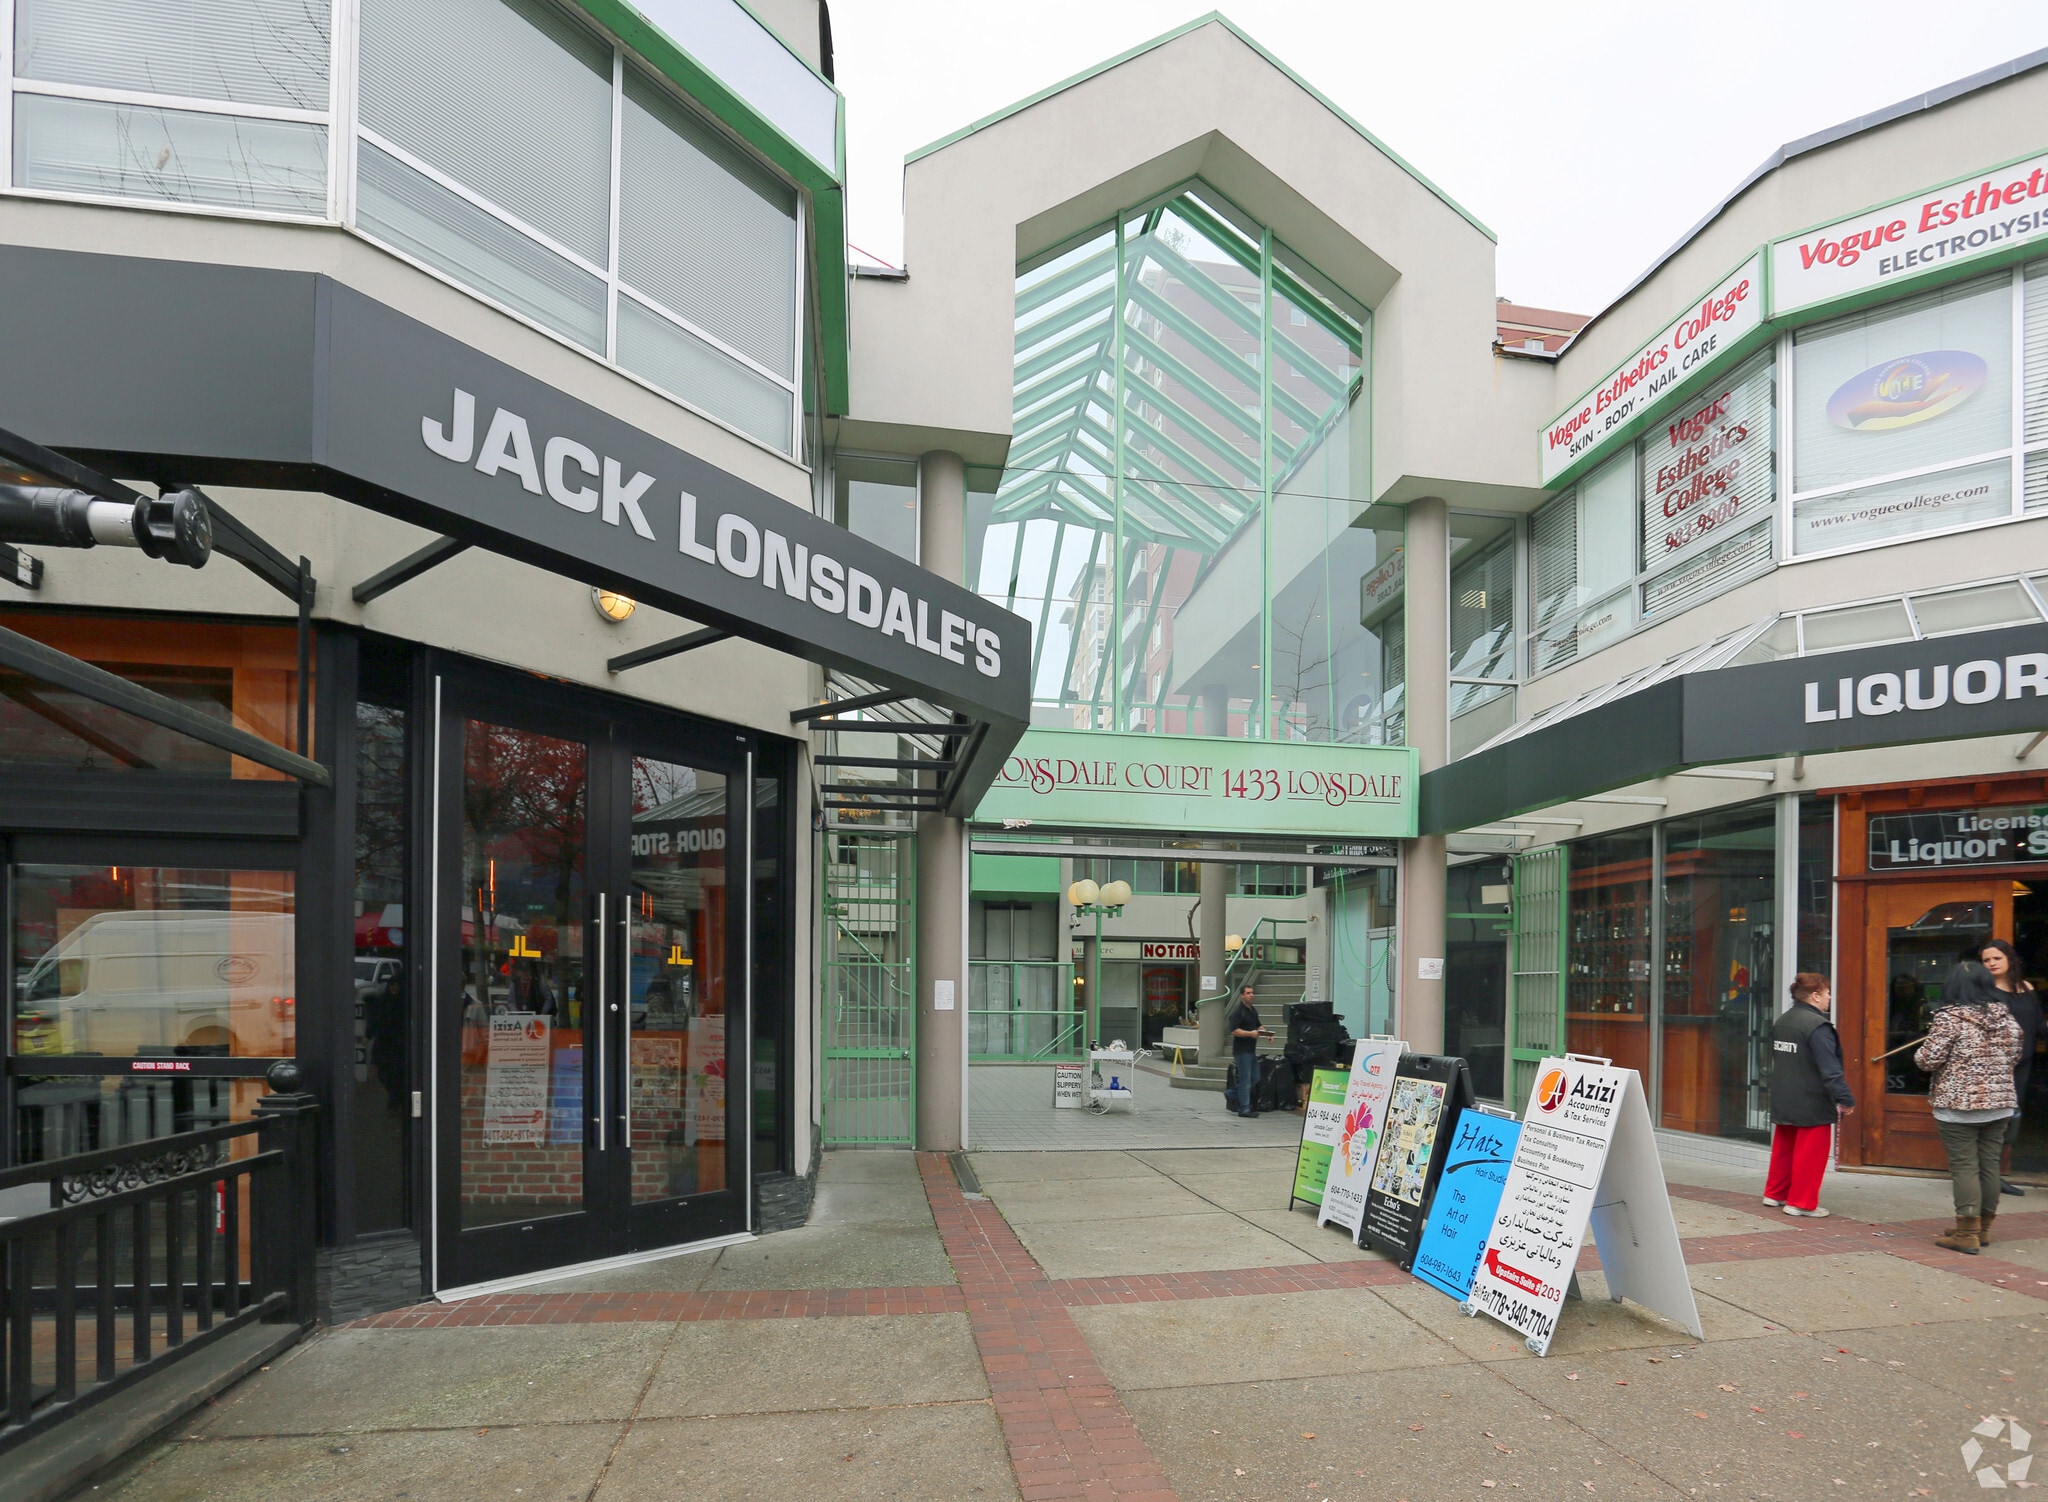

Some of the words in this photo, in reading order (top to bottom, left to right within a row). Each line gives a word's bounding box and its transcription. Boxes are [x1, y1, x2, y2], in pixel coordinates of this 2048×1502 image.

[1799, 219, 1907, 270] Vogue
[1548, 406, 1592, 451] Vogue
[1595, 343, 1669, 416] Esthetics
[1673, 278, 1750, 350] College
[1569, 429, 1594, 458] SKIN
[1605, 398, 1636, 431] BODY
[1648, 366, 1678, 398] NAIL
[1682, 333, 1718, 371] CARE
[1668, 391, 1732, 449] Vogue
[1656, 419, 1749, 496] Esthetics
[1663, 458, 1741, 519] College
[1809, 485, 1990, 530] www.voguecollege.com
[420, 386, 657, 542] JACK
[678, 490, 1002, 678] LONSDALE'S
[1804, 651, 2048, 724] LIQUOR
[994, 756, 1118, 795] ONSDALE
[1125, 762, 1213, 791] COURT
[1220, 768, 1281, 801] 1433
[1287, 769, 1402, 807] LONSDALE
[1890, 836, 2007, 865] Liquor
[1143, 943, 1200, 959] NOTAR
[156, 1061, 174, 1070] STAND
[175, 1061, 190, 1071] BACK
[1056, 1071, 1082, 1080] CAUTION
[1570, 1074, 1618, 1104] Azizi
[1563, 1109, 1569, 1118] &
[1570, 1111, 1581, 1121] Tax
[1582, 1114, 1607, 1127] Services
[1567, 1099, 1611, 1118] Accounting
[1455, 1122, 1504, 1157] Hatz
[1523, 1134, 1533, 1143] Tax
[1533, 1136, 1559, 1151] Consulting
[1526, 1124, 1547, 1136] Personal
[1552, 1130, 1575, 1143] Business
[1576, 1136, 1586, 1146] Tax
[1586, 1138, 1604, 1150] Return
[1474, 1166, 1488, 1179] Hair
[1517, 1156, 1538, 1169] Business
[1538, 1162, 1550, 1171] Plan
[1520, 1145, 1547, 1160] Accounting
[1552, 1153, 1585, 1171] Bookkeeping
[1452, 1188, 1466, 1204] The
[1446, 1207, 1458, 1220] Art
[1458, 1211, 1469, 1225] of
[1440, 1223, 1458, 1241] Hair
[1420, 1253, 1462, 1282] 604-987-1643
[1495, 1264, 1520, 1283] Upstairs
[1520, 1275, 1536, 1291] Suite
[1541, 1284, 1561, 1302] 203
